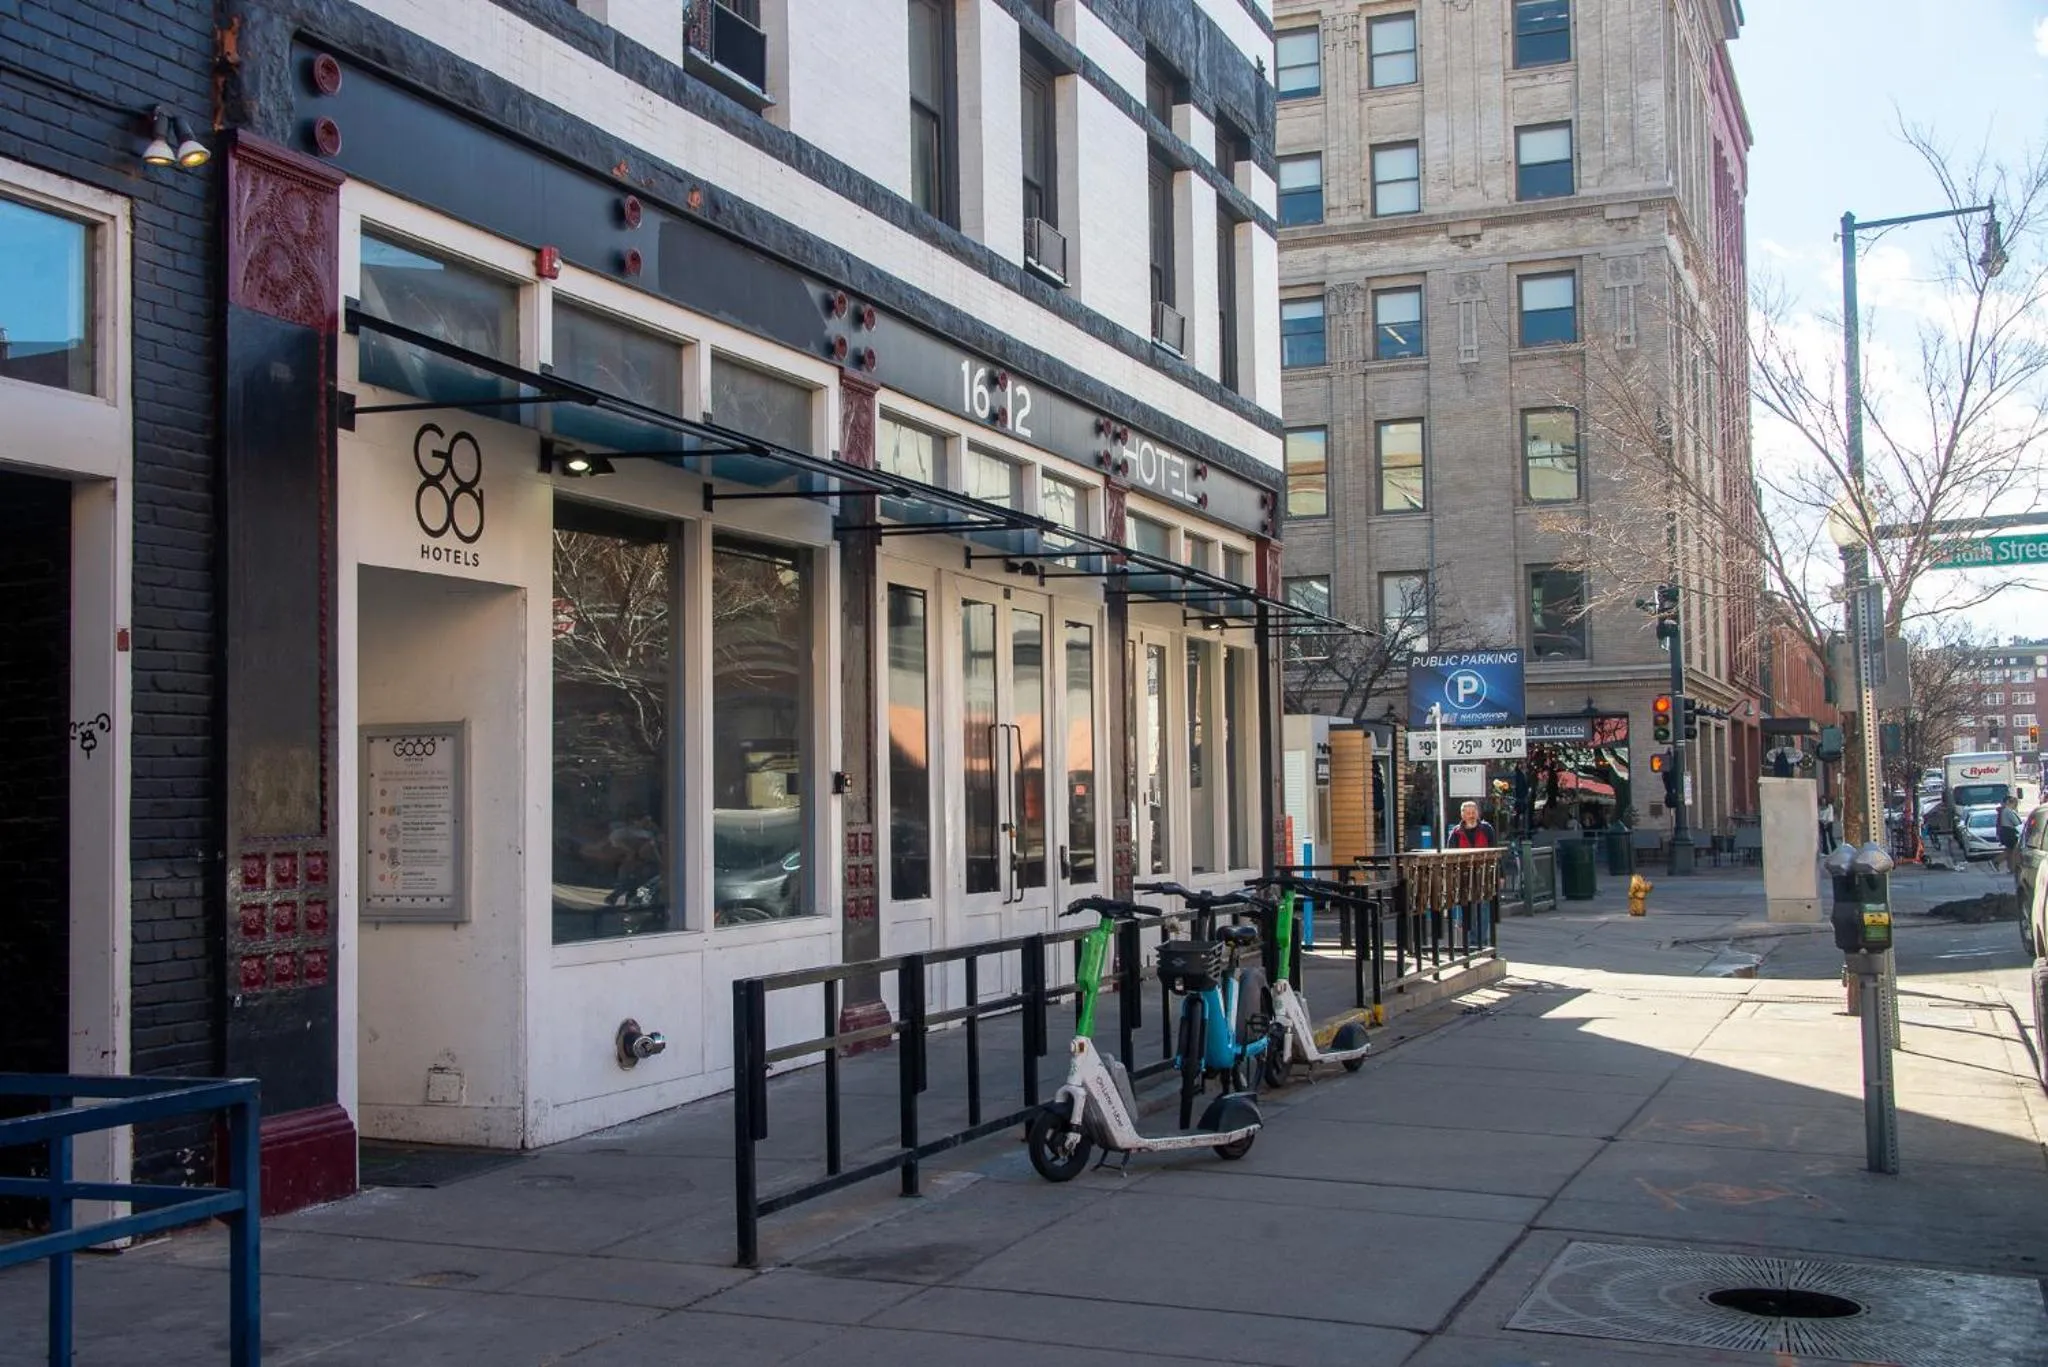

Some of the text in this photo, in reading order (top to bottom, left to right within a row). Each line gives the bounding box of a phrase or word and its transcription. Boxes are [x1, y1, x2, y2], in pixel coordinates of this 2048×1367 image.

[1122, 438, 1199, 503] HOTEL
[421, 544, 480, 567] HOTELS
[1412, 652, 1518, 667] PUBLIC PARKING
[1970, 766, 2000, 777] Ryder
